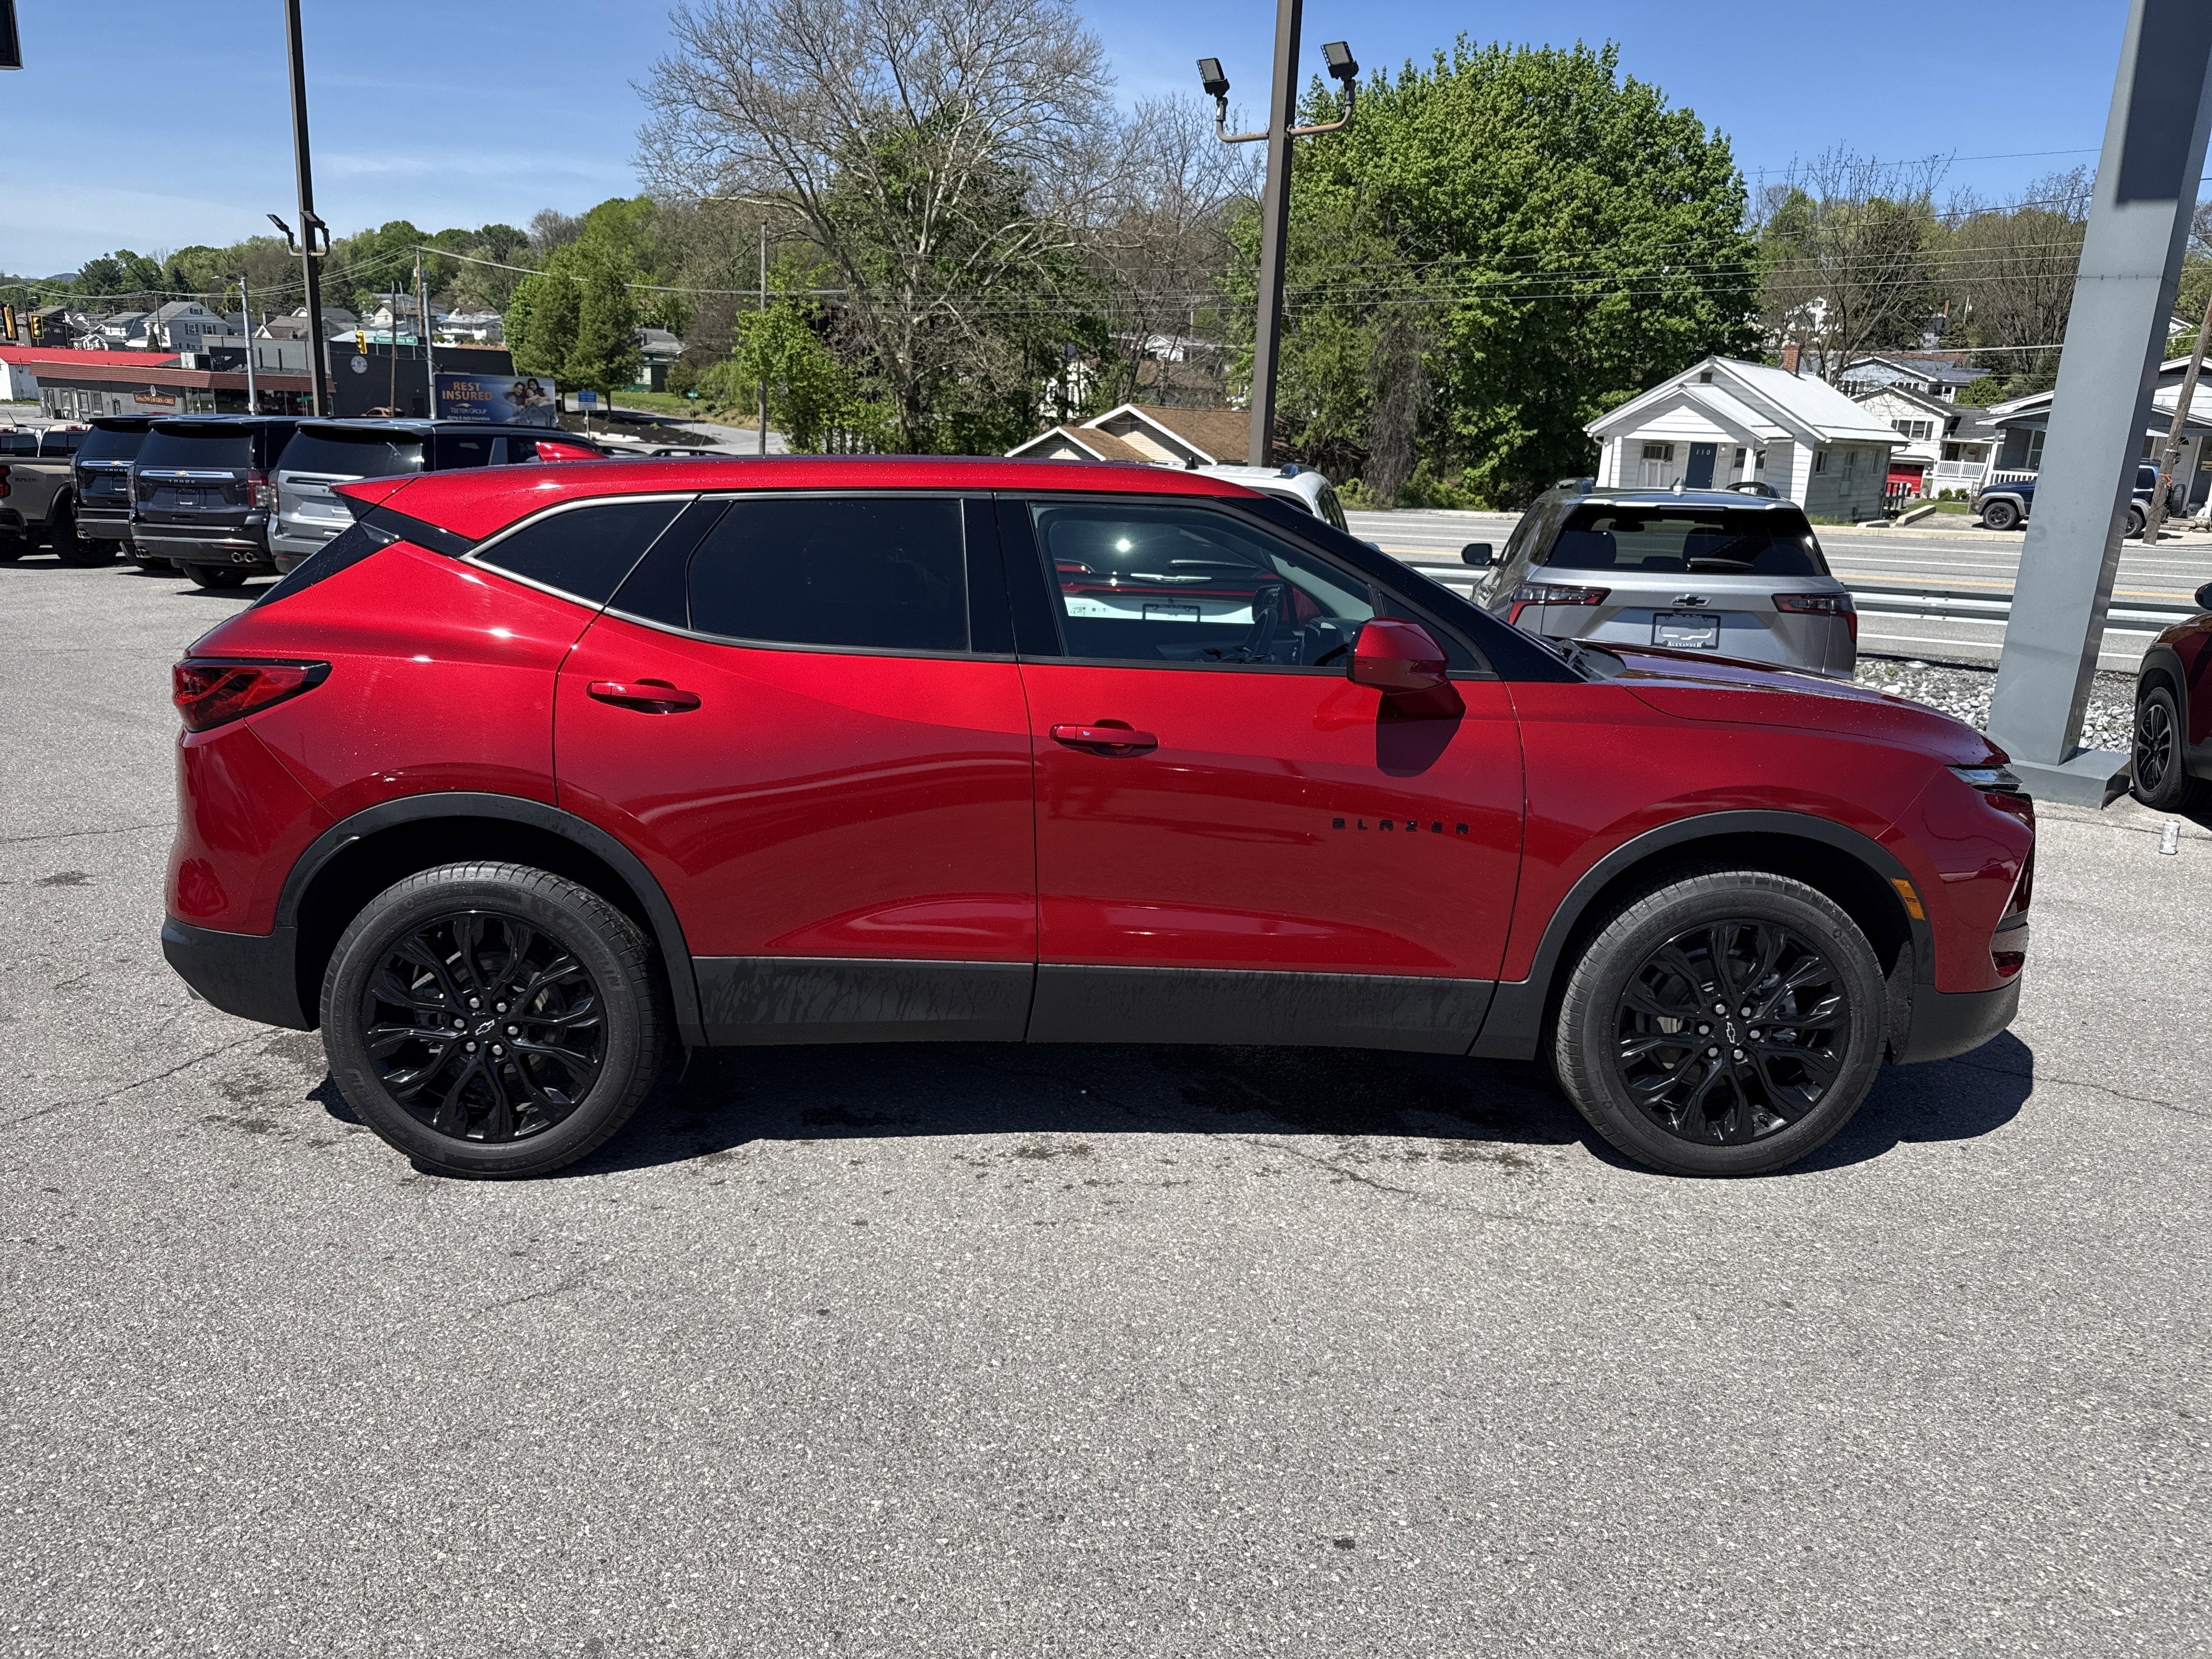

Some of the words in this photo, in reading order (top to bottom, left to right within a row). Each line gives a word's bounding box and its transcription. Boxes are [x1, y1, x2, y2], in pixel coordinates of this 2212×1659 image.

[453, 382, 481, 391] REST
[442, 390, 493, 401] INSURED
[1332, 818, 1470, 834] BLAZER
[555, 916, 621, 987] MICHELIN
[336, 978, 348, 1006] TOUR
